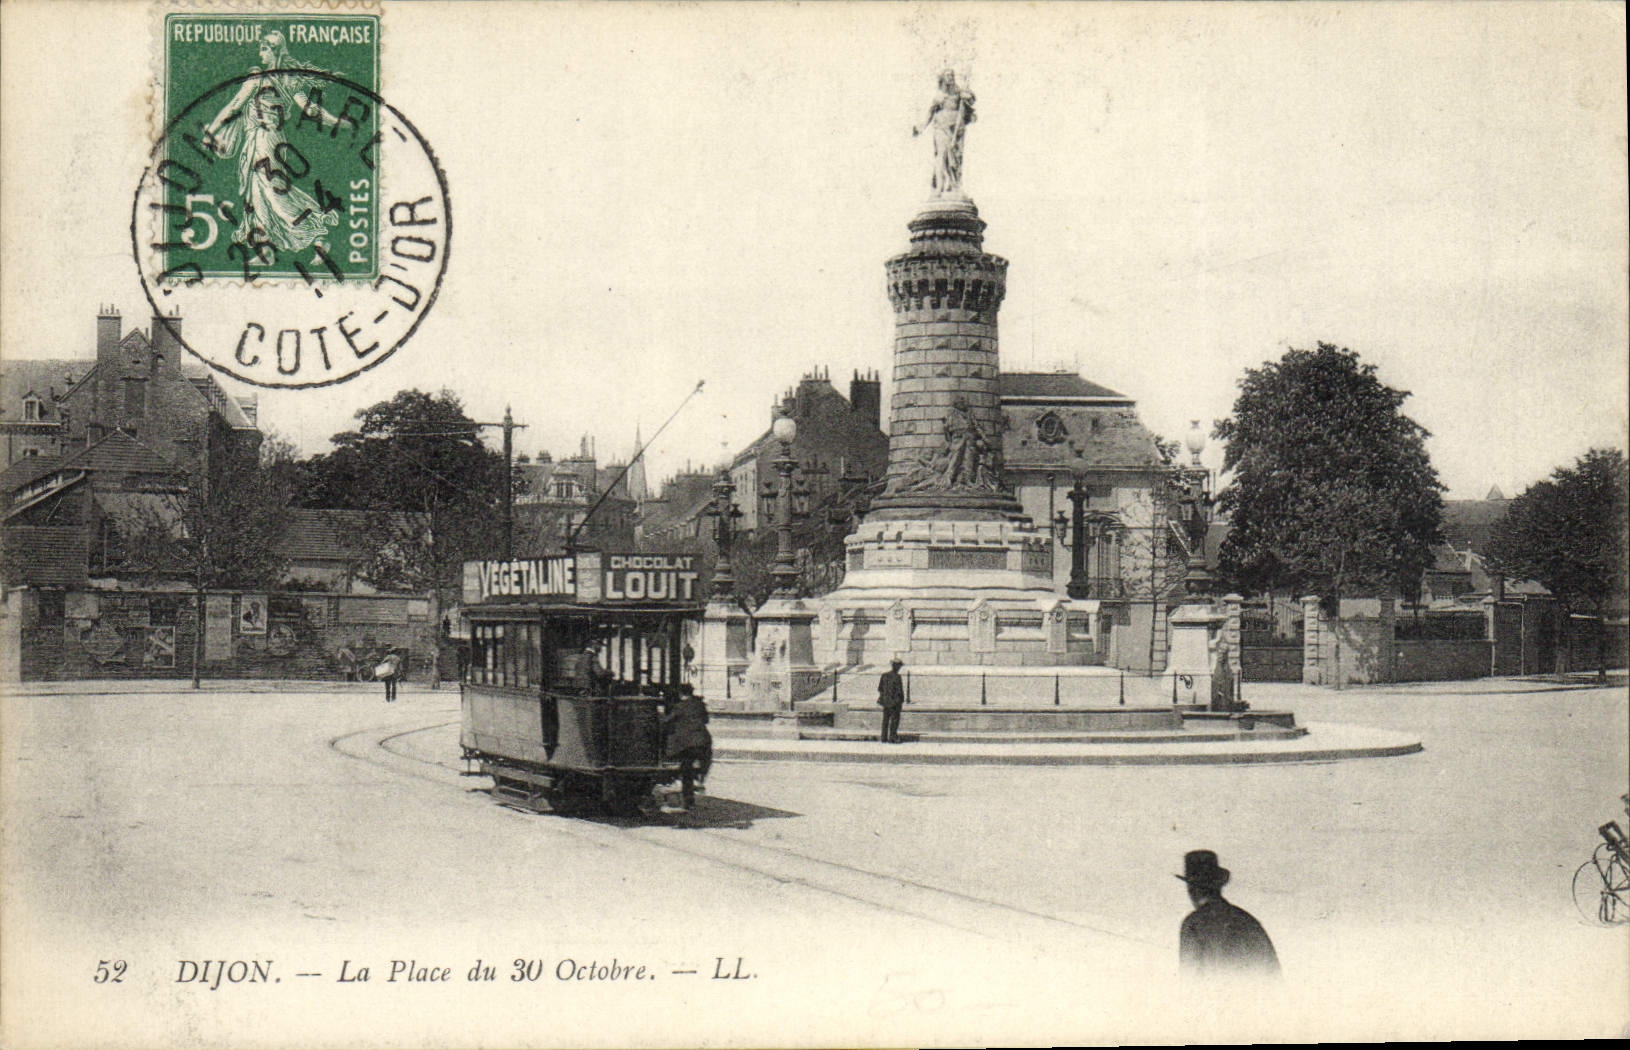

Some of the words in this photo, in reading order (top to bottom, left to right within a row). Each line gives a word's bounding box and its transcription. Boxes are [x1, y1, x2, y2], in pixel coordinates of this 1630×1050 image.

[289, 25, 371, 46] FRANÇAISE
[349, 178, 370, 263] POSTES
[610, 556, 693, 570] CHOCOLAT
[606, 571, 698, 600] LOUIT
